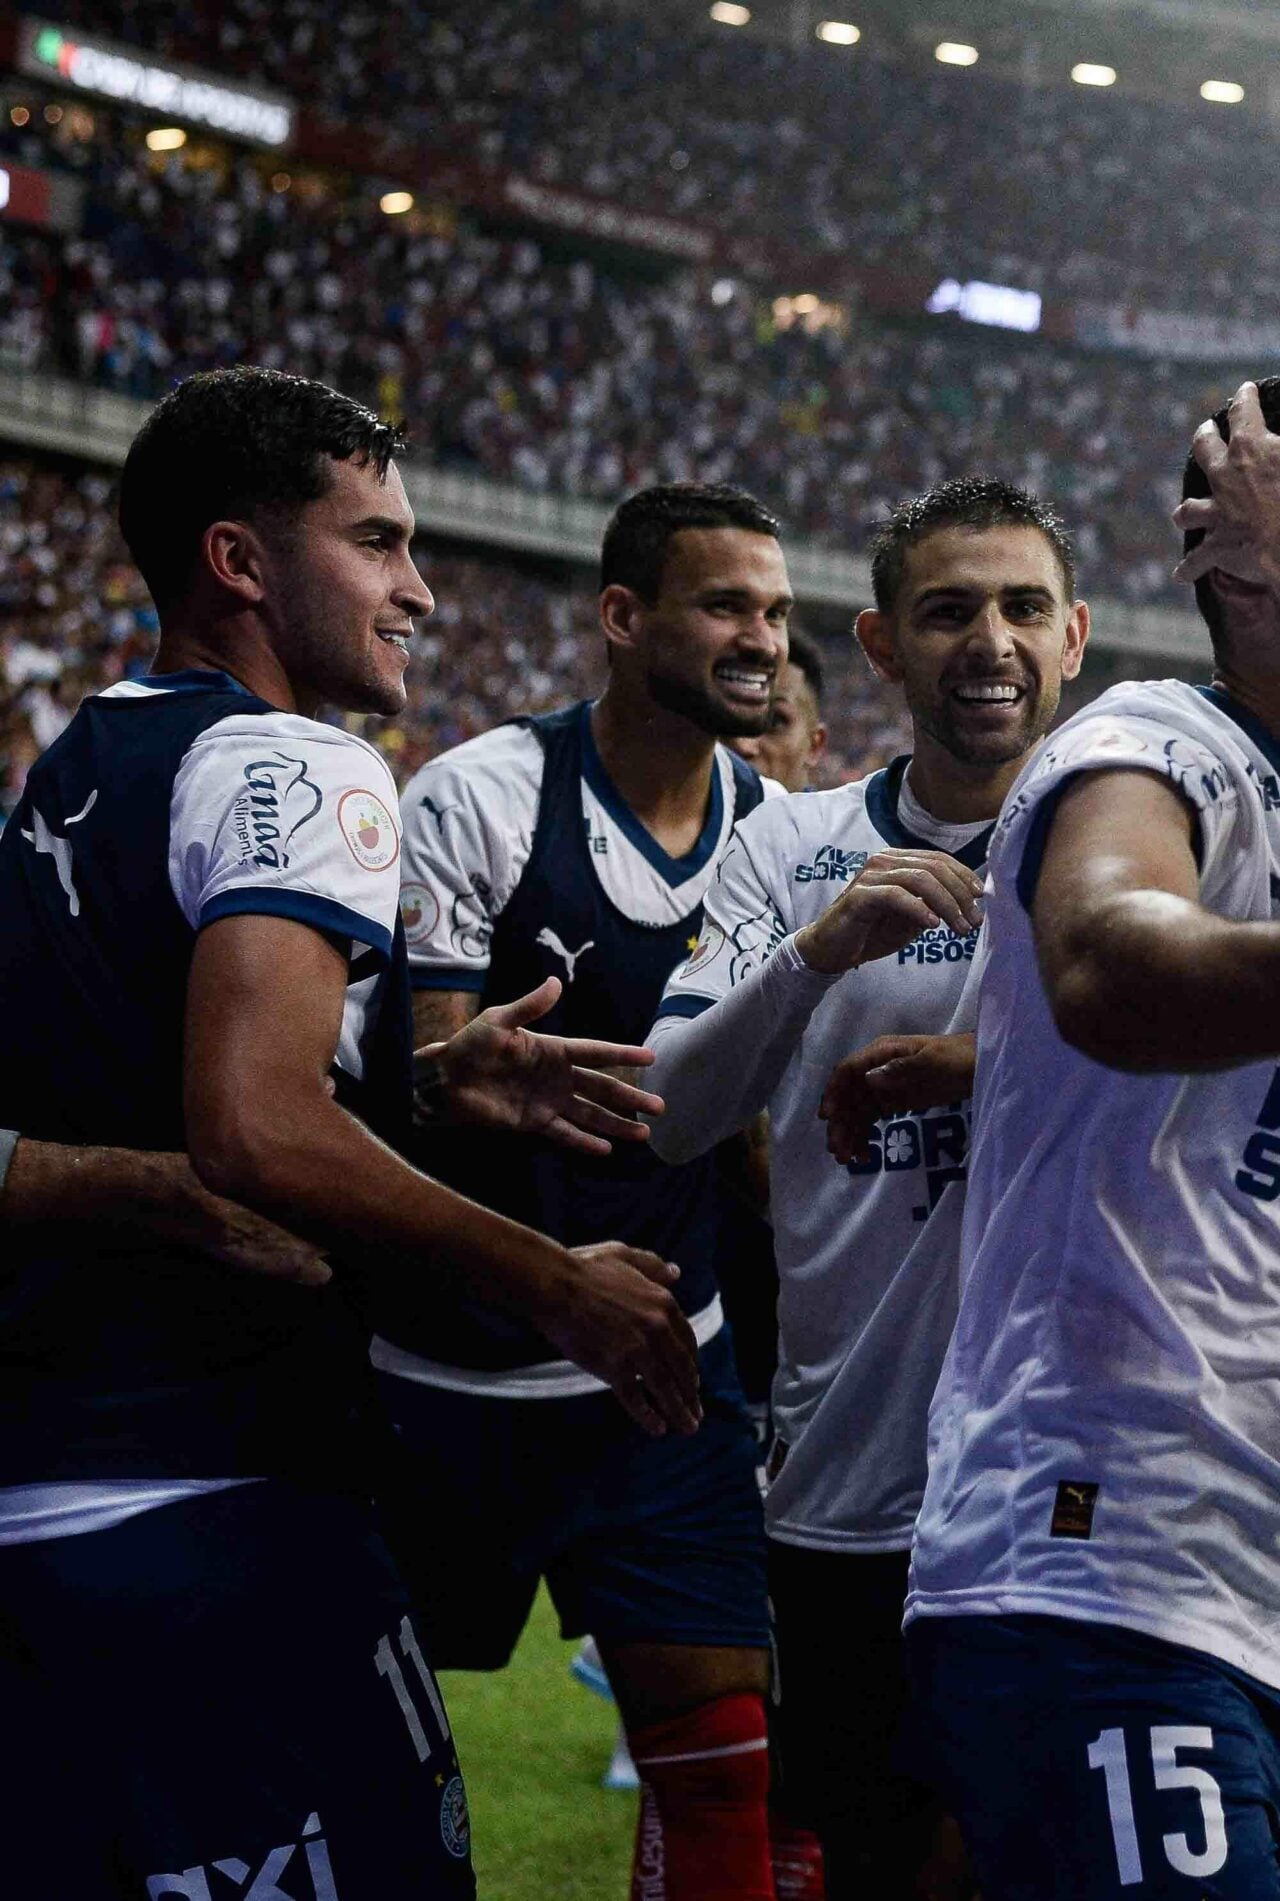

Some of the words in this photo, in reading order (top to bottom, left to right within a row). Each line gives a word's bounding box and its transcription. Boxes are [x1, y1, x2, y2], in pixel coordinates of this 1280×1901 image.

[244, 761, 290, 868] Canaã
[372, 1615, 450, 1762] 11
[1088, 1725, 1229, 1886] 15
